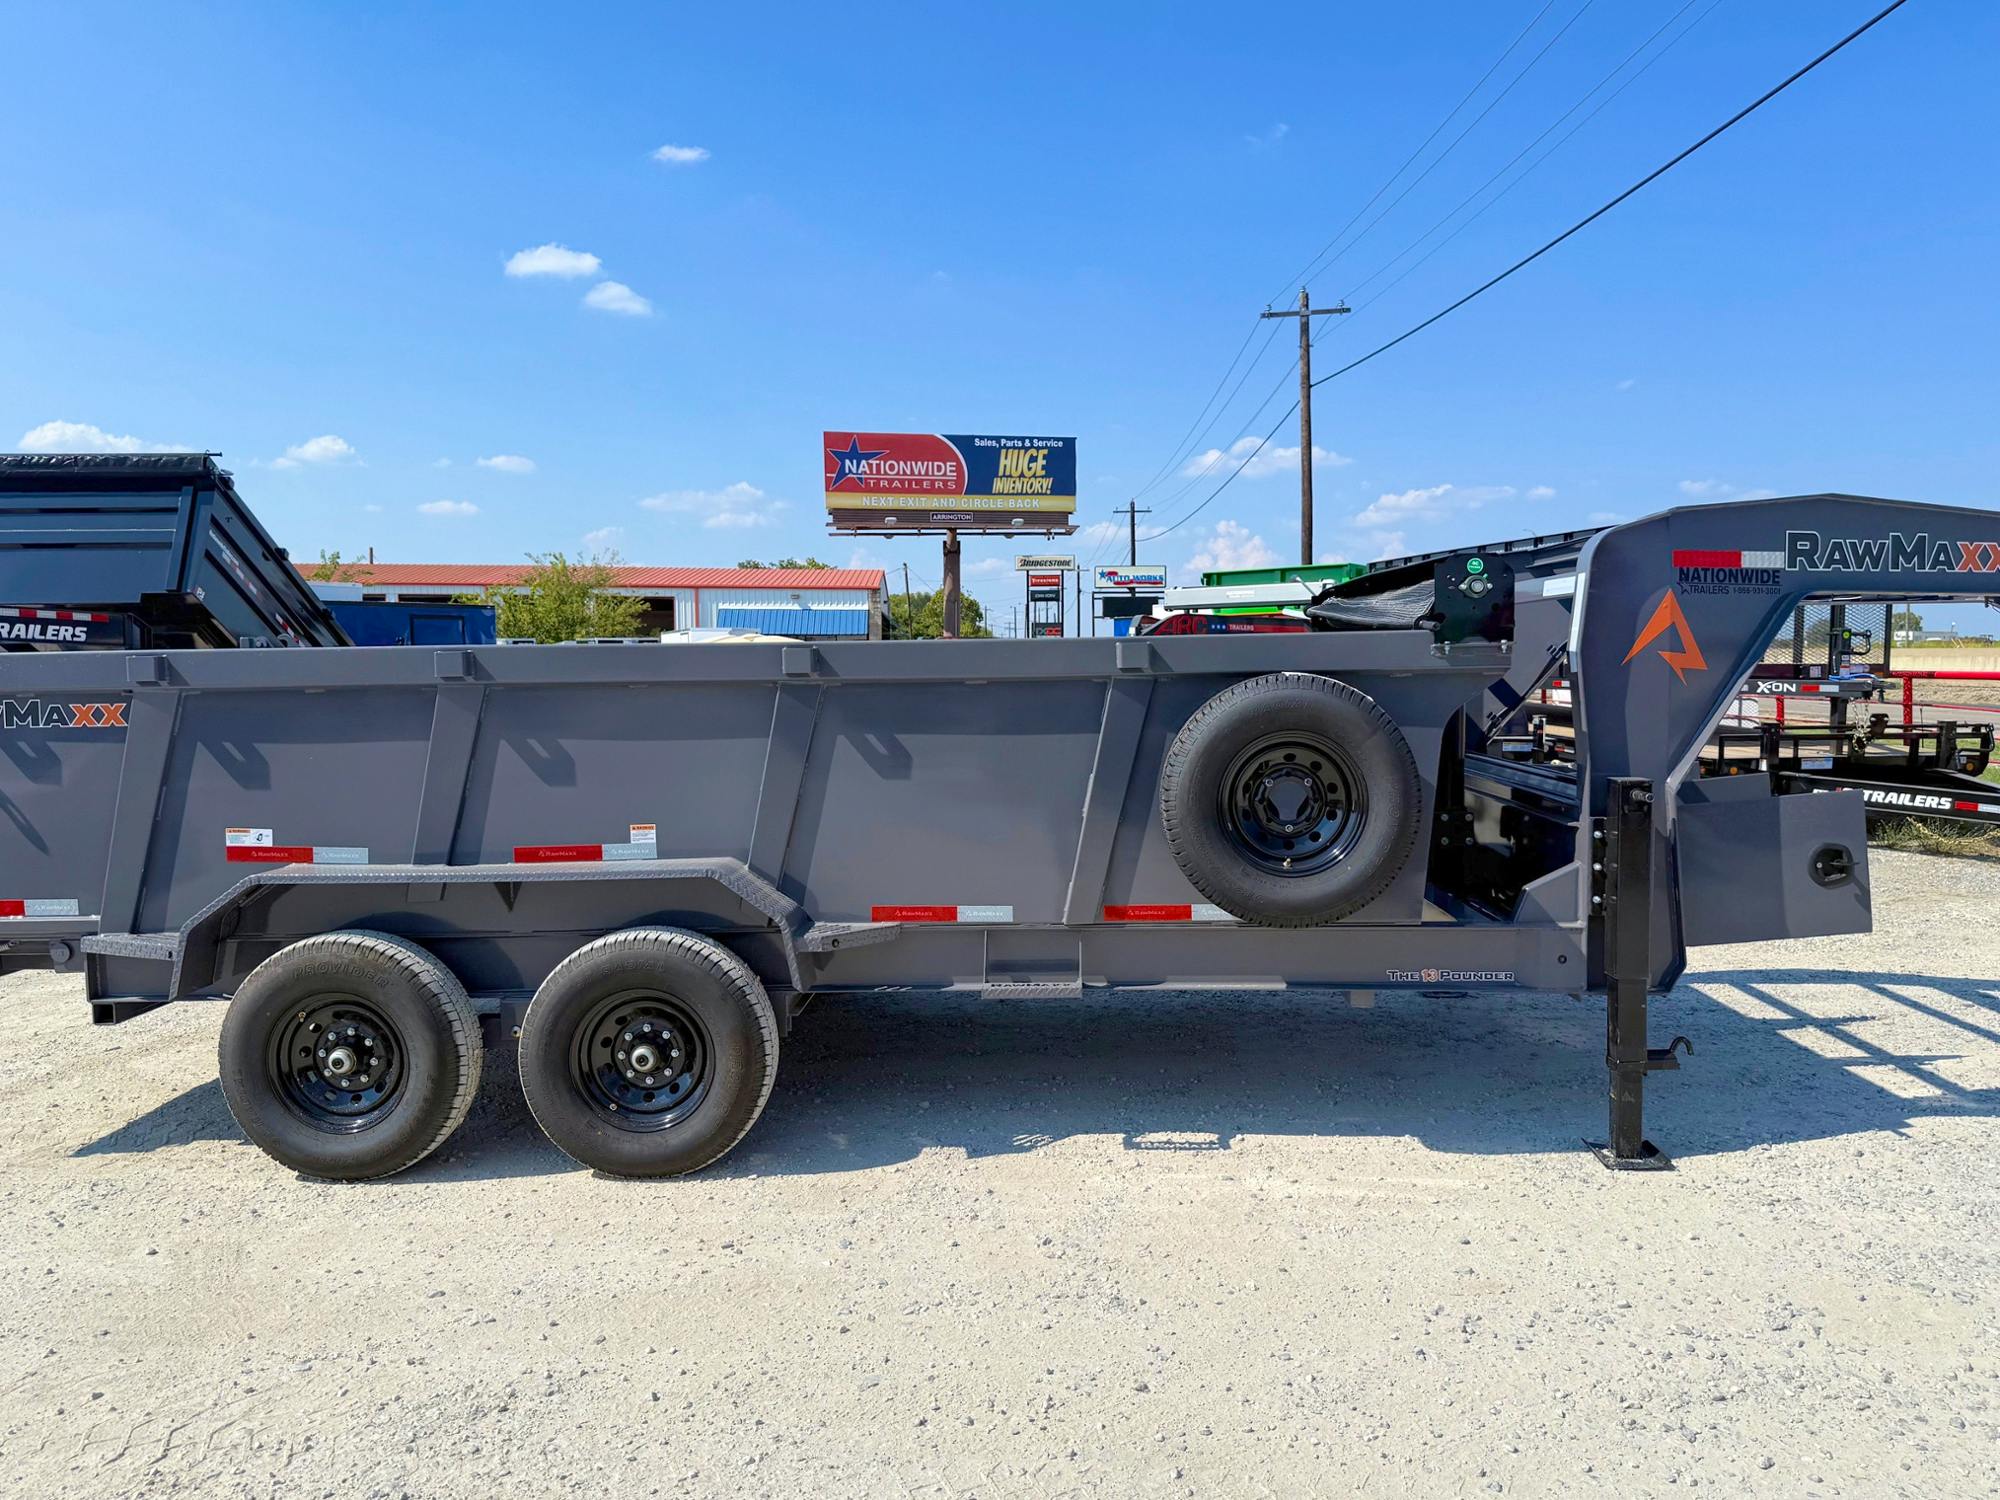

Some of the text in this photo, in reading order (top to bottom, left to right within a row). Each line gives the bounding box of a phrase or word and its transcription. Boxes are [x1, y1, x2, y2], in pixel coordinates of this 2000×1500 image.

[974, 438, 1064, 448] Sales, Parts & Service
[844, 458, 957, 476] NATIONWIDE
[998, 448, 1048, 477] HUGE
[867, 480, 956, 489] TRAILERS
[992, 477, 1053, 494] INVENTORY!
[862, 496, 1040, 508] NEXT EXIT AND CIRCLE BACK
[932, 513, 972, 521] ARRINGTON
[1019, 558, 1072, 567] BRIDGESTONE
[1106, 575, 1130, 583] AUTO
[1678, 567, 1781, 584] NATIONWIDE
[1690, 584, 1730, 595] TRAILERS
[0, 699, 128, 729] MAXX
[1862, 789, 1952, 809] TRAILERS
[1386, 969, 1420, 981] THE
[1438, 969, 1515, 981] POUNDER
